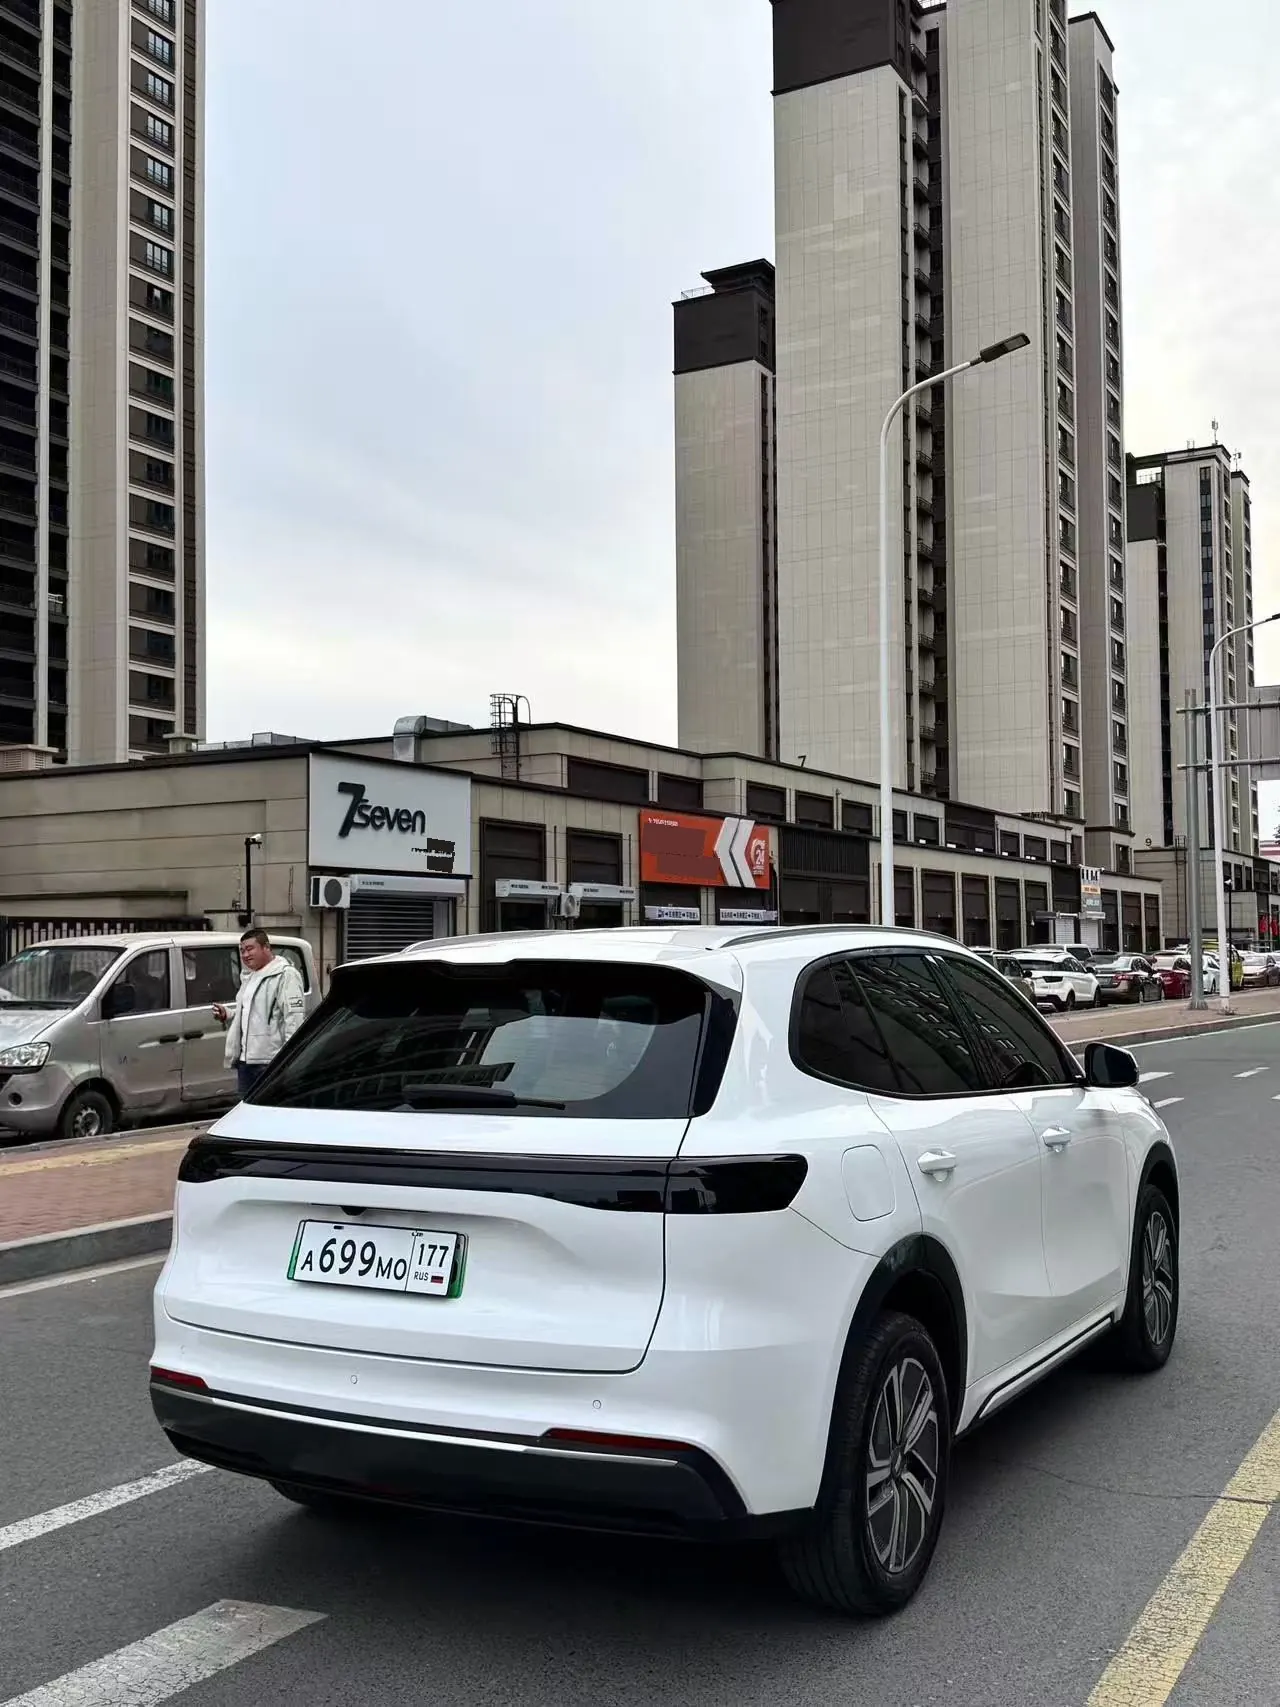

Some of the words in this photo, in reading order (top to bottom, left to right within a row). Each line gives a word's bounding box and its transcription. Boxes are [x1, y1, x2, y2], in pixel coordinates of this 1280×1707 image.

[1145, 838, 1152, 847] 9
[418, 1243, 450, 1268] 177
[414, 1271, 429, 1281] RUS
